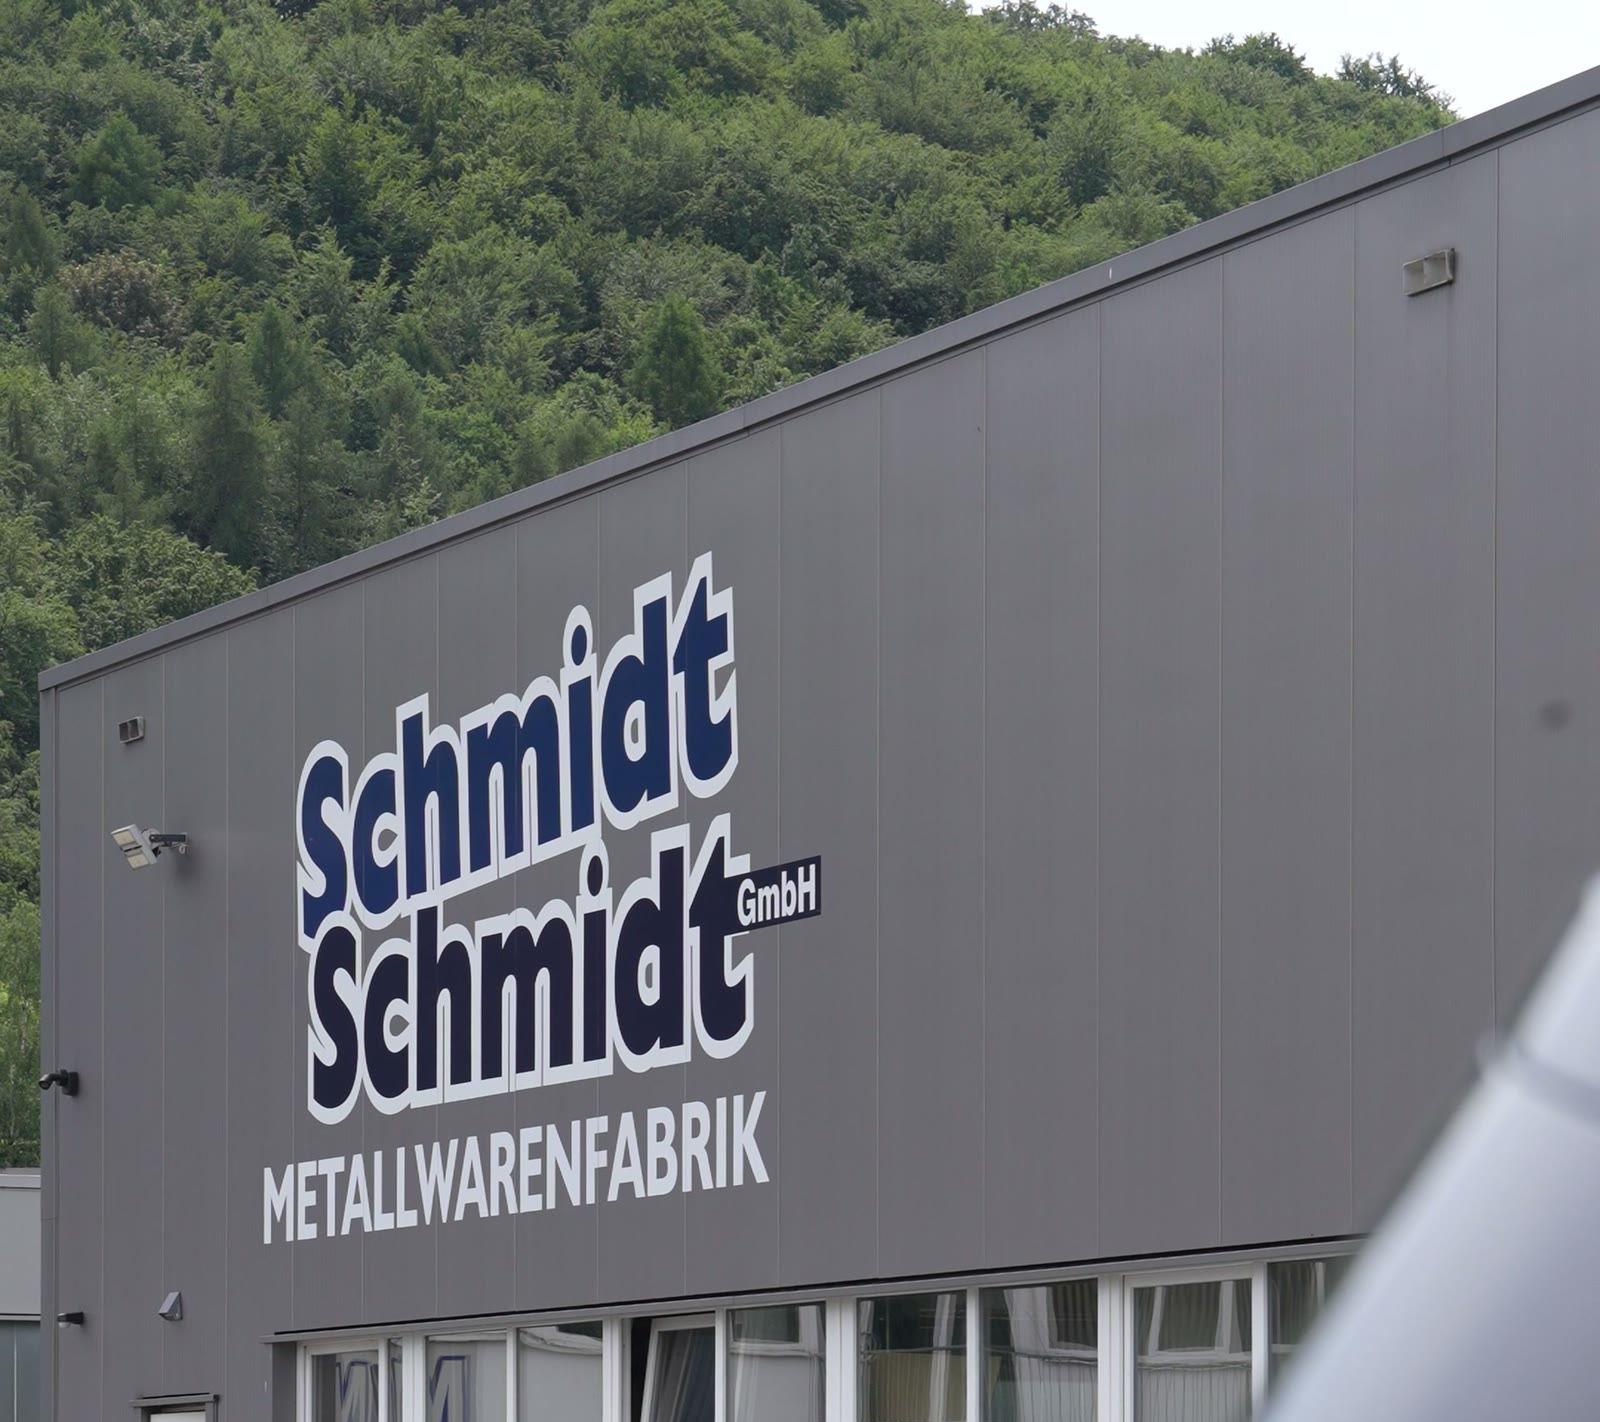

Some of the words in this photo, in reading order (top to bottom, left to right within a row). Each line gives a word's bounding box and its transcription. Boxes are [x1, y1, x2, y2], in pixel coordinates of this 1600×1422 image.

[298, 552, 738, 948] Schmidt
[308, 814, 754, 1124] Schmidt
[737, 864, 816, 927] GmbH
[263, 1091, 769, 1244] METALLWARENFABRIK
